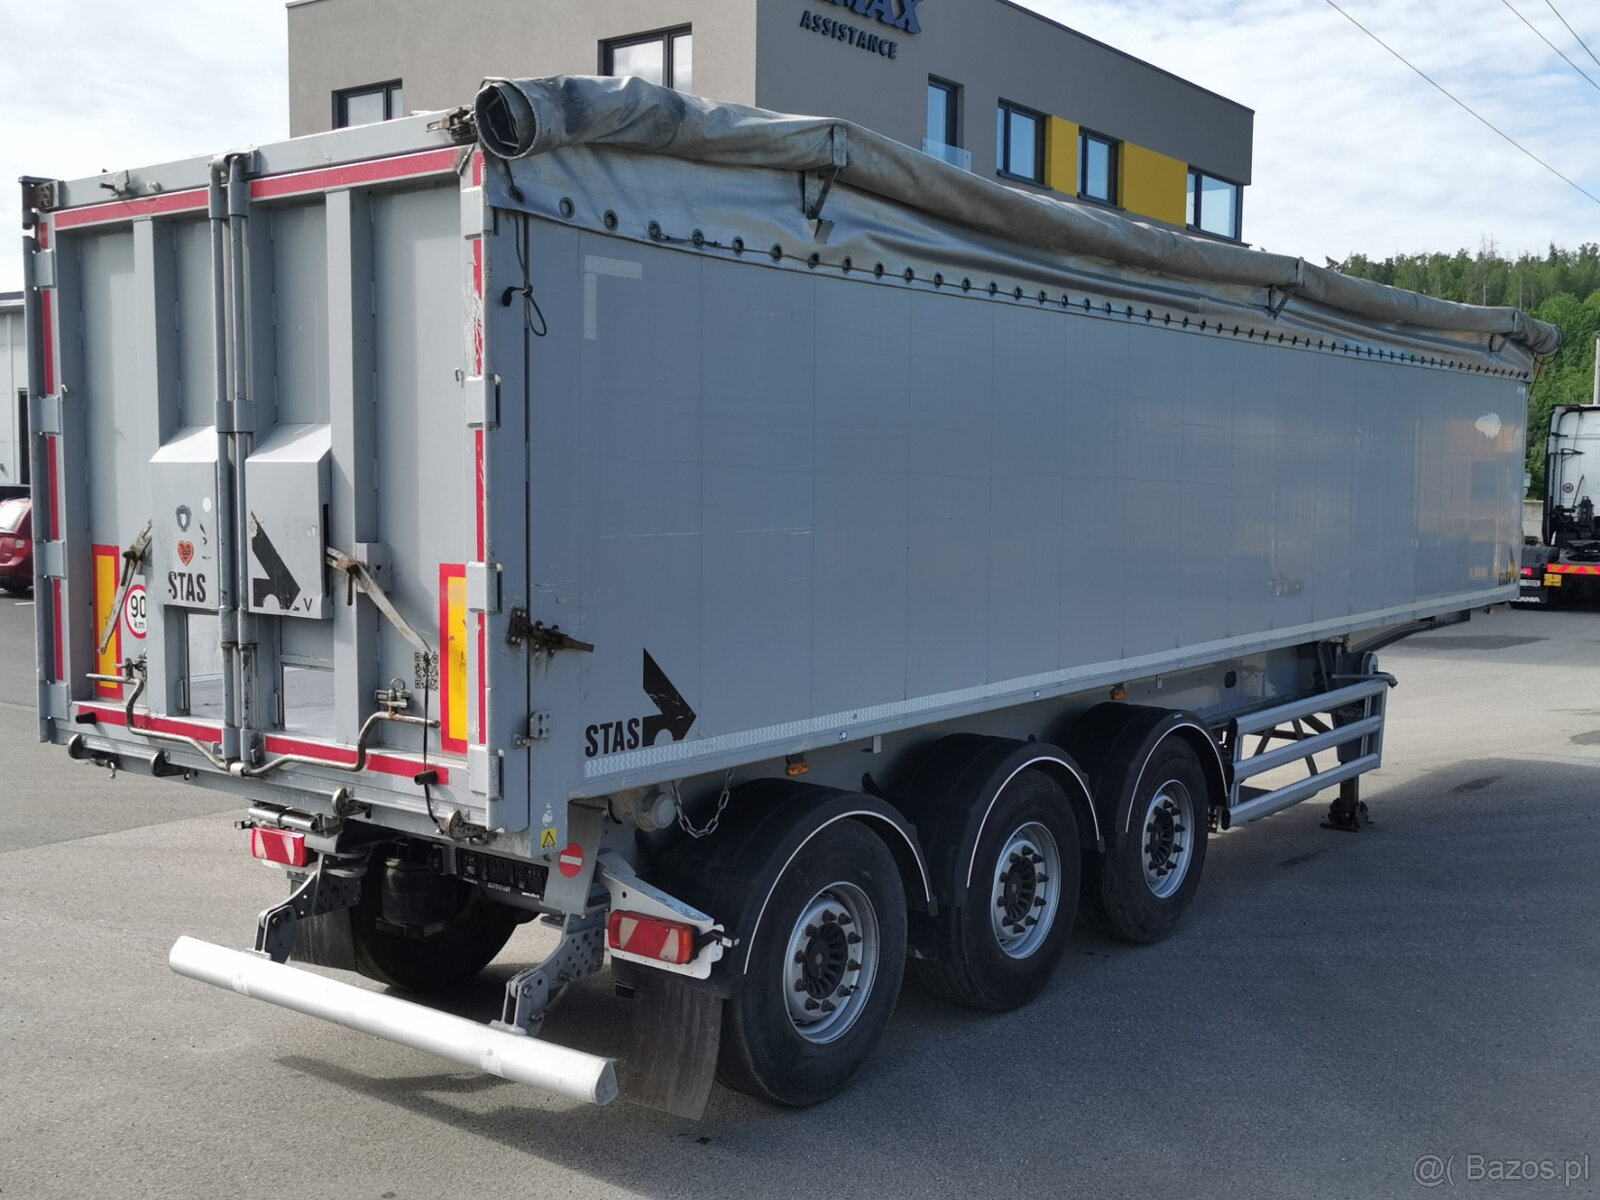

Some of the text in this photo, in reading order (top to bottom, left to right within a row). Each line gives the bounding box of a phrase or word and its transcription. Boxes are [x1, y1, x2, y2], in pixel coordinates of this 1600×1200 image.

[799, 10, 898, 59] ASSISTANCE
[168, 571, 206, 602] STAS
[131, 595, 146, 618] 90
[585, 718, 640, 757] STAS
